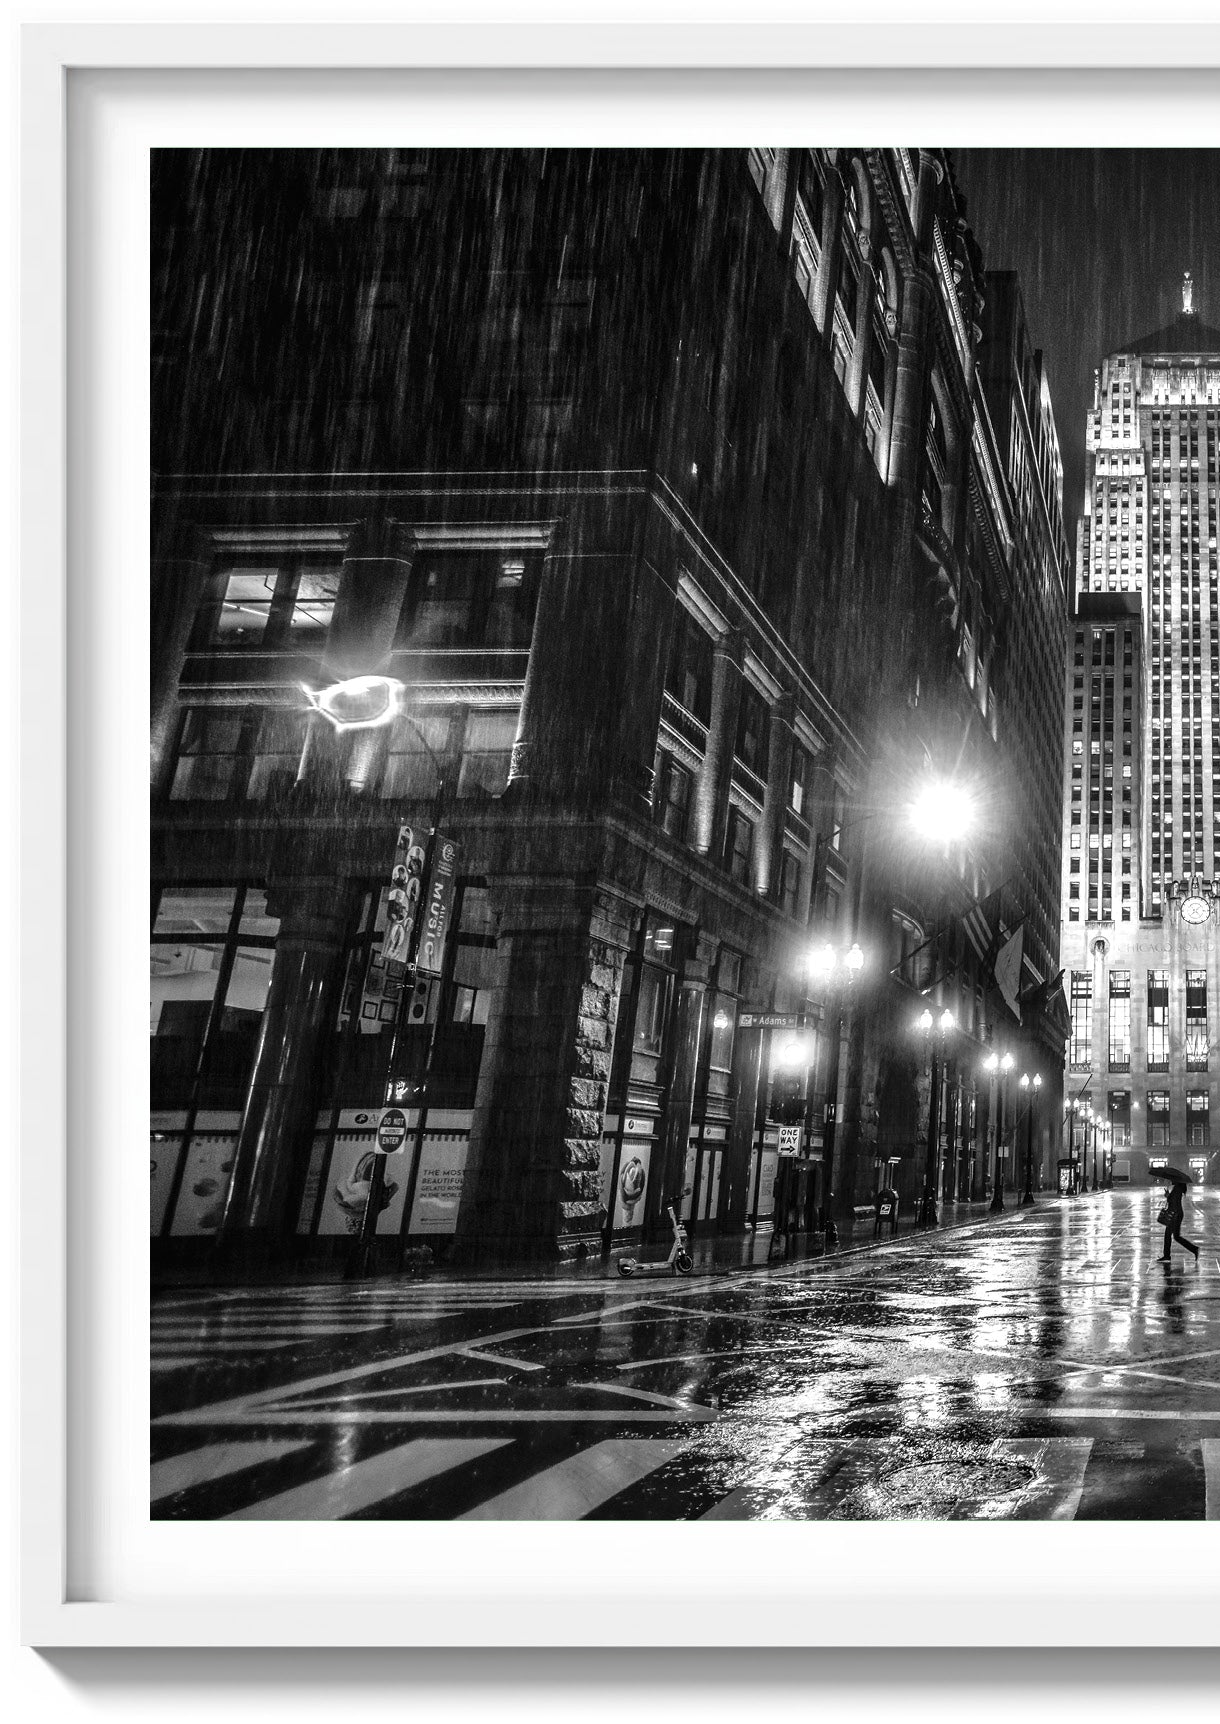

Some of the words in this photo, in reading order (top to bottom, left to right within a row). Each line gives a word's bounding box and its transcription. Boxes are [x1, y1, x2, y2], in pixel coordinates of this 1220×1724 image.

[424, 882, 444, 955] MUSIC
[1118, 943, 1174, 953] CHICAGO
[759, 1016, 787, 1026] Adams
[382, 1117, 392, 1125] DO
[393, 1117, 404, 1126] NOT
[382, 1136, 400, 1145] ENTER
[780, 1136, 798, 1144] WAY
[424, 1169, 441, 1177] THE
[422, 1177, 463, 1185] BEAUTIFUL
